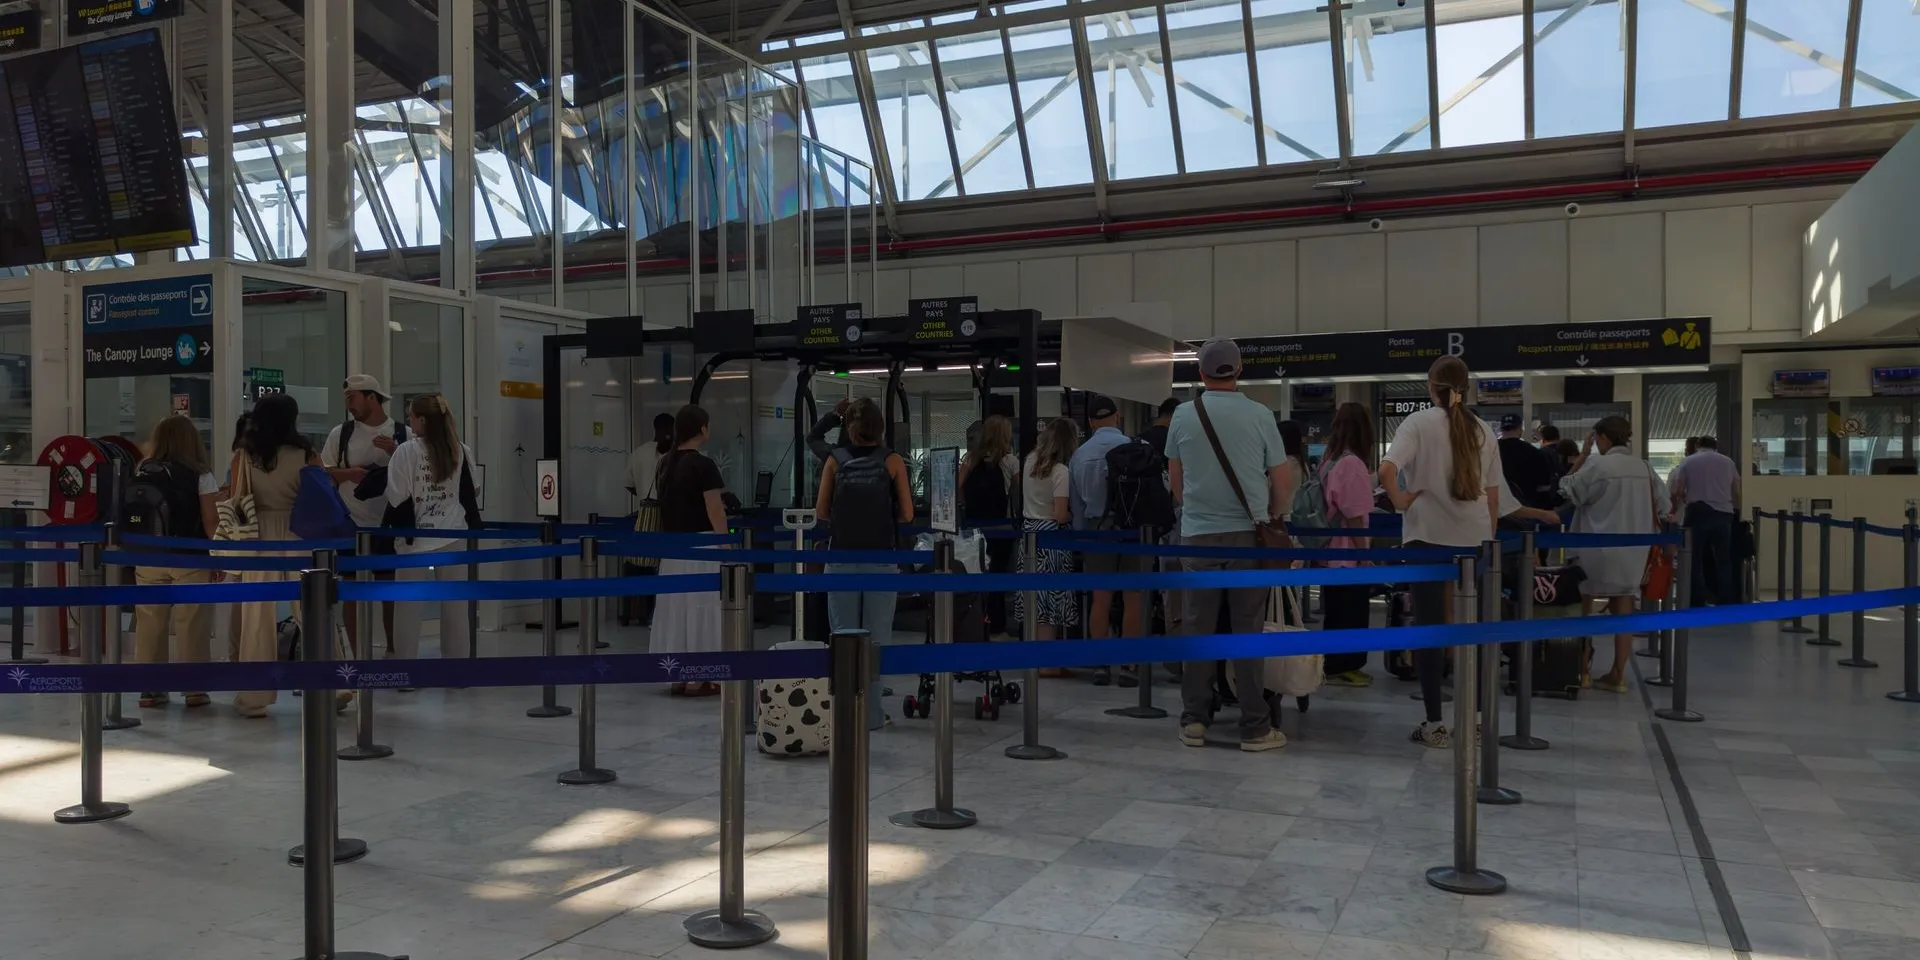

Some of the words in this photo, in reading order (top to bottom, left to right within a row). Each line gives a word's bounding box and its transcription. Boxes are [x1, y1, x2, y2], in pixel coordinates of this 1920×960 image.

[96, 14, 114, 24] Canopy
[114, 10, 133, 20] Lounge
[109, 292, 137, 305] Contrôle
[138, 292, 150, 302] des
[150, 289, 188, 303] passeports
[921, 301, 948, 310] AUTRES
[808, 307, 835, 316] AUTRES
[925, 310, 944, 319] PAYS
[813, 316, 831, 324] PAYS
[922, 321, 946, 330] OTHER
[810, 327, 833, 336] OTHER
[915, 330, 954, 340] COUNTRIES
[1556, 329, 1597, 340] Contrôle
[1599, 328, 1651, 340] passeports
[803, 336, 840, 345] COUNTRIES
[1388, 338, 1416, 346] Portes
[1447, 332, 1465, 358] B
[1240, 344, 1259, 353] trôle
[1260, 343, 1303, 355] passeports
[1554, 342, 1583, 352] control
[85, 348, 102, 362] The
[105, 347, 137, 363] Canopy
[140, 345, 173, 362] Lounge
